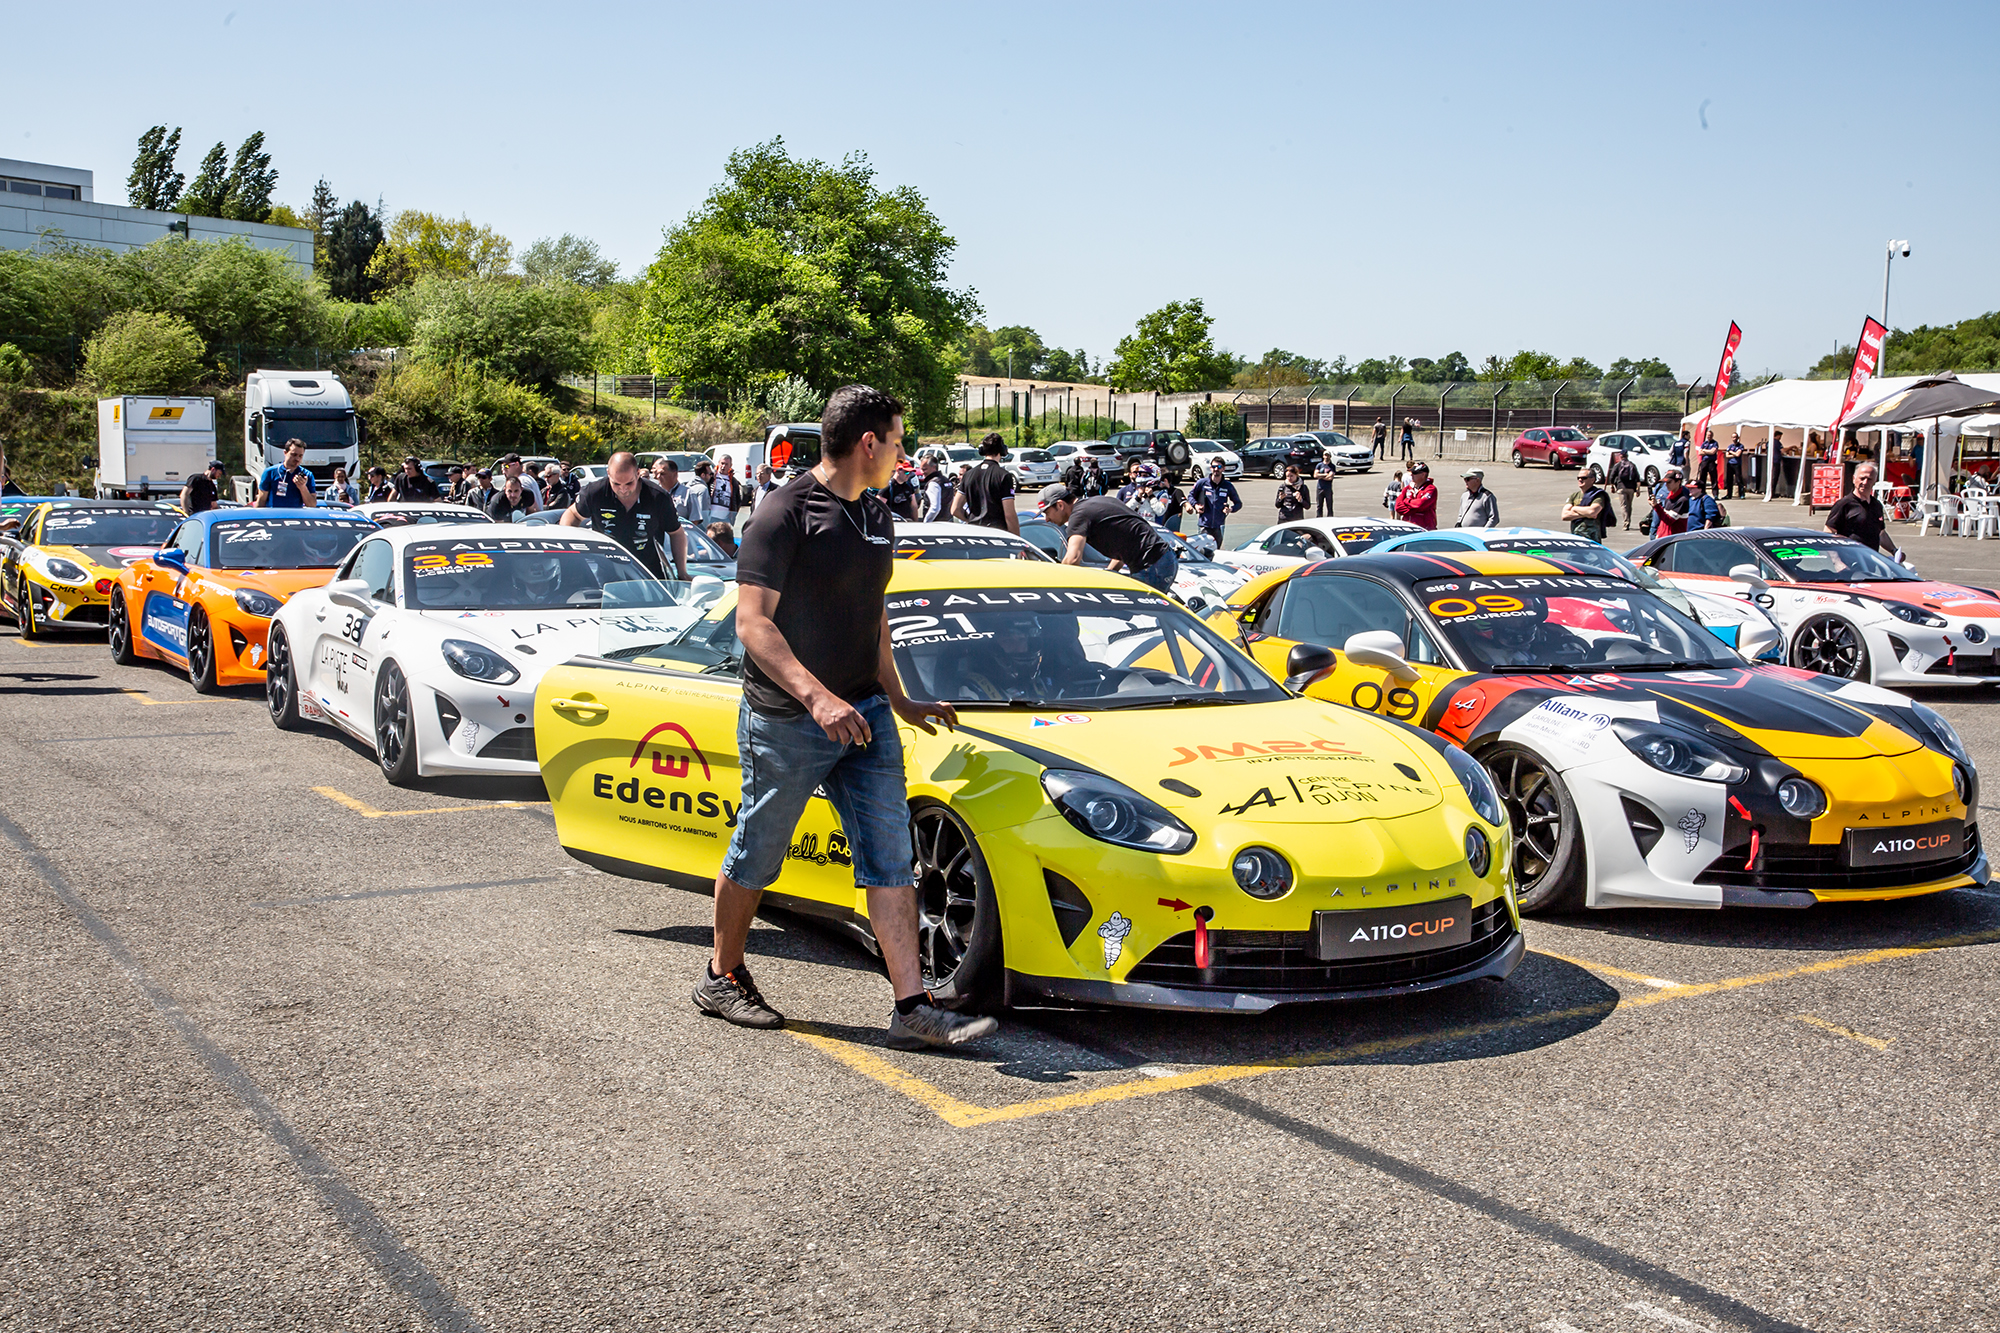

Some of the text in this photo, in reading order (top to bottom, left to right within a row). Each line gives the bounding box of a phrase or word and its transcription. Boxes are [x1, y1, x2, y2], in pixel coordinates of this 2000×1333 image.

[160, 408, 172, 417] JB
[45, 517, 96, 527] 64
[246, 520, 352, 528] ALPINE
[219, 529, 272, 541] 74
[1337, 532, 1372, 541] 07
[1783, 538, 1848, 546] ALPINE
[450, 541, 590, 550] ALPINE
[898, 538, 1007, 547] ALPINE
[1771, 547, 1820, 558] 29
[412, 552, 494, 570] 38
[50, 583, 78, 594] CMR
[1425, 585, 1447, 593] elf
[1469, 579, 1612, 592] ALPINE
[887, 599, 914, 609] elf
[943, 592, 1135, 606] ALPINE
[1428, 595, 1525, 617] 09
[342, 613, 363, 643] 38
[510, 615, 664, 640] LA PISTE
[887, 612, 978, 642] 21
[890, 631, 995, 650] M.GUILLOT
[1350, 681, 1420, 721] 09
[1538, 698, 1589, 722] Allianz
[1298, 775, 1352, 785] CENTRE
[1308, 781, 1435, 797] ALPINE
[1311, 791, 1378, 806] DIJON
[1858, 804, 1953, 821] ALPINE
[619, 815, 718, 839] NOUS ABRITONS VOS AMBITIONS
[1871, 833, 1951, 854] A110CUP
[1331, 878, 1457, 897] ALPINE
[1348, 917, 1456, 943] A110CUP
